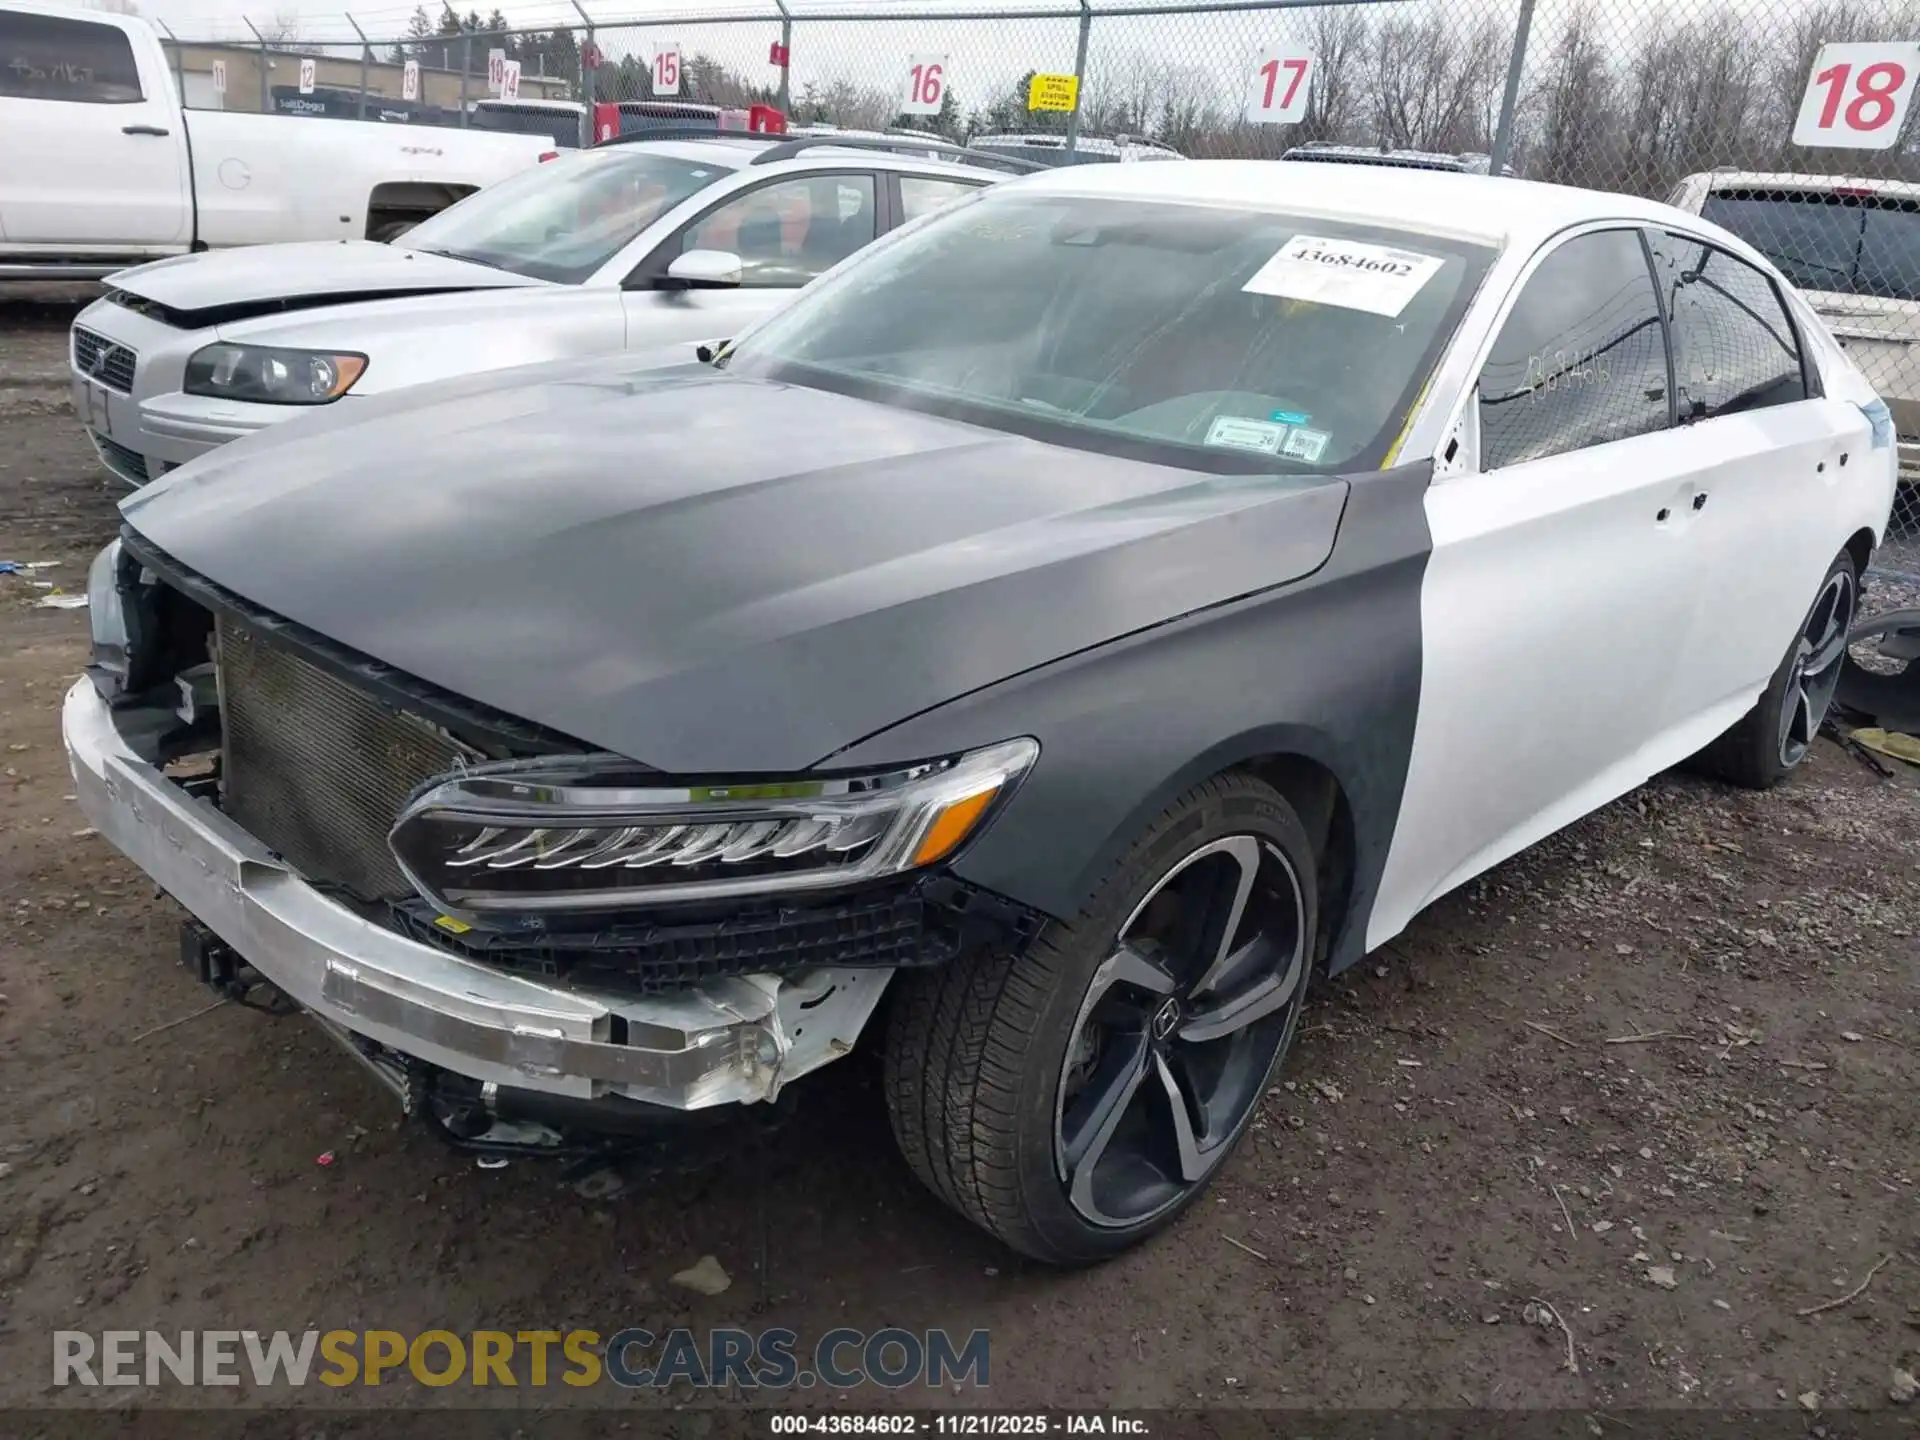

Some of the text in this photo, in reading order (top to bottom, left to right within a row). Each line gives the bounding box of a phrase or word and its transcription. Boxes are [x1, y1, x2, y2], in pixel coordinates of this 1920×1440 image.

[215, 66, 224, 89] 11
[302, 65, 312, 89] 12
[490, 57, 504, 84] 10
[656, 51, 677, 85] 15
[504, 69, 517, 97] 14
[911, 63, 943, 104] 16
[1260, 59, 1308, 109] 17
[1816, 62, 1906, 132] 18
[1292, 248, 1413, 277] 43684602
